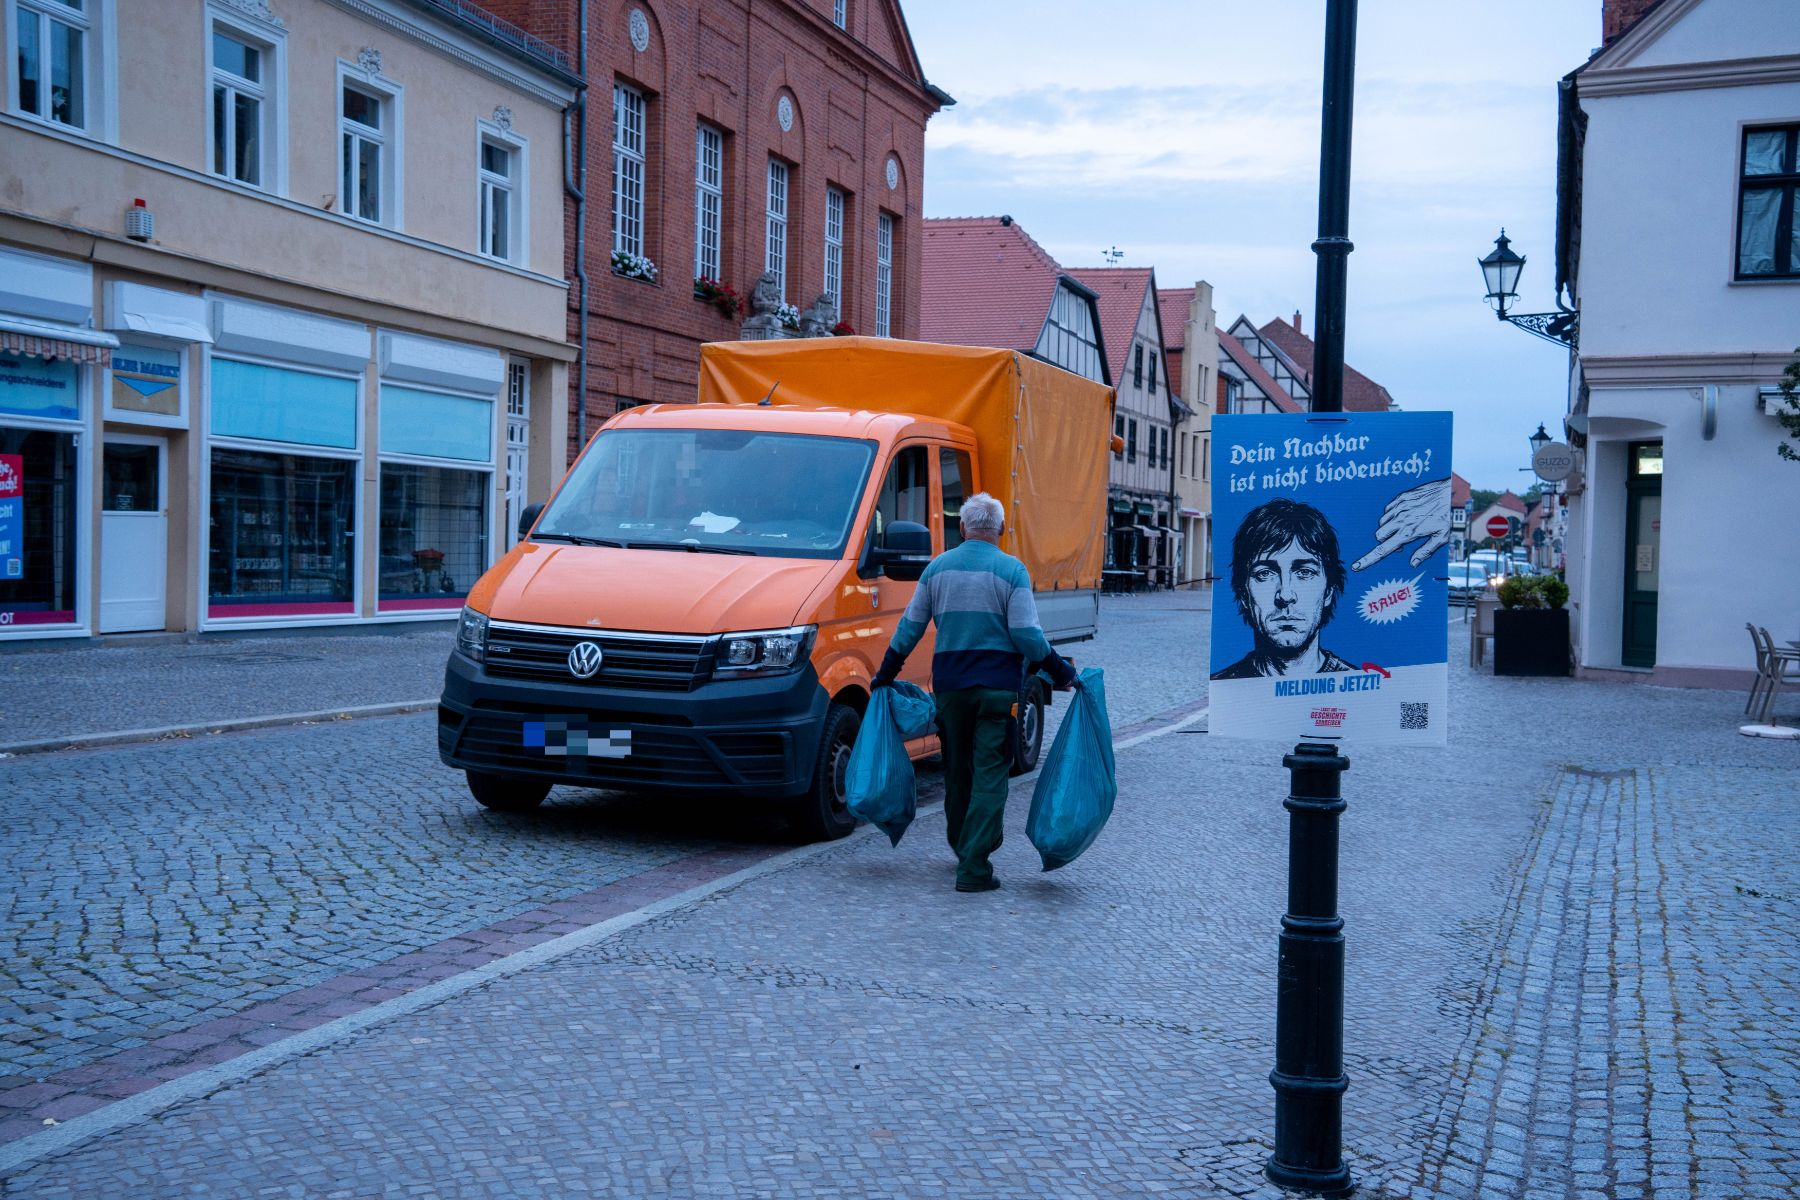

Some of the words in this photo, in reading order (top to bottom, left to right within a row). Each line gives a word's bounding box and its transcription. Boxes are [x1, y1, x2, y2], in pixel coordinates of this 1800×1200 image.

[1230, 442, 1275, 465] Dein
[1283, 432, 1370, 459] Nachbar
[1230, 471, 1256, 493] ist
[1262, 465, 1308, 491] nicht
[1315, 448, 1432, 483] biodeutsch?
[1536, 457, 1570, 465] GUZZO
[1275, 677, 1335, 696] MELDUNG
[1340, 673, 1380, 692] JETZT!
[1311, 711, 1347, 720] GESCHICHTE
